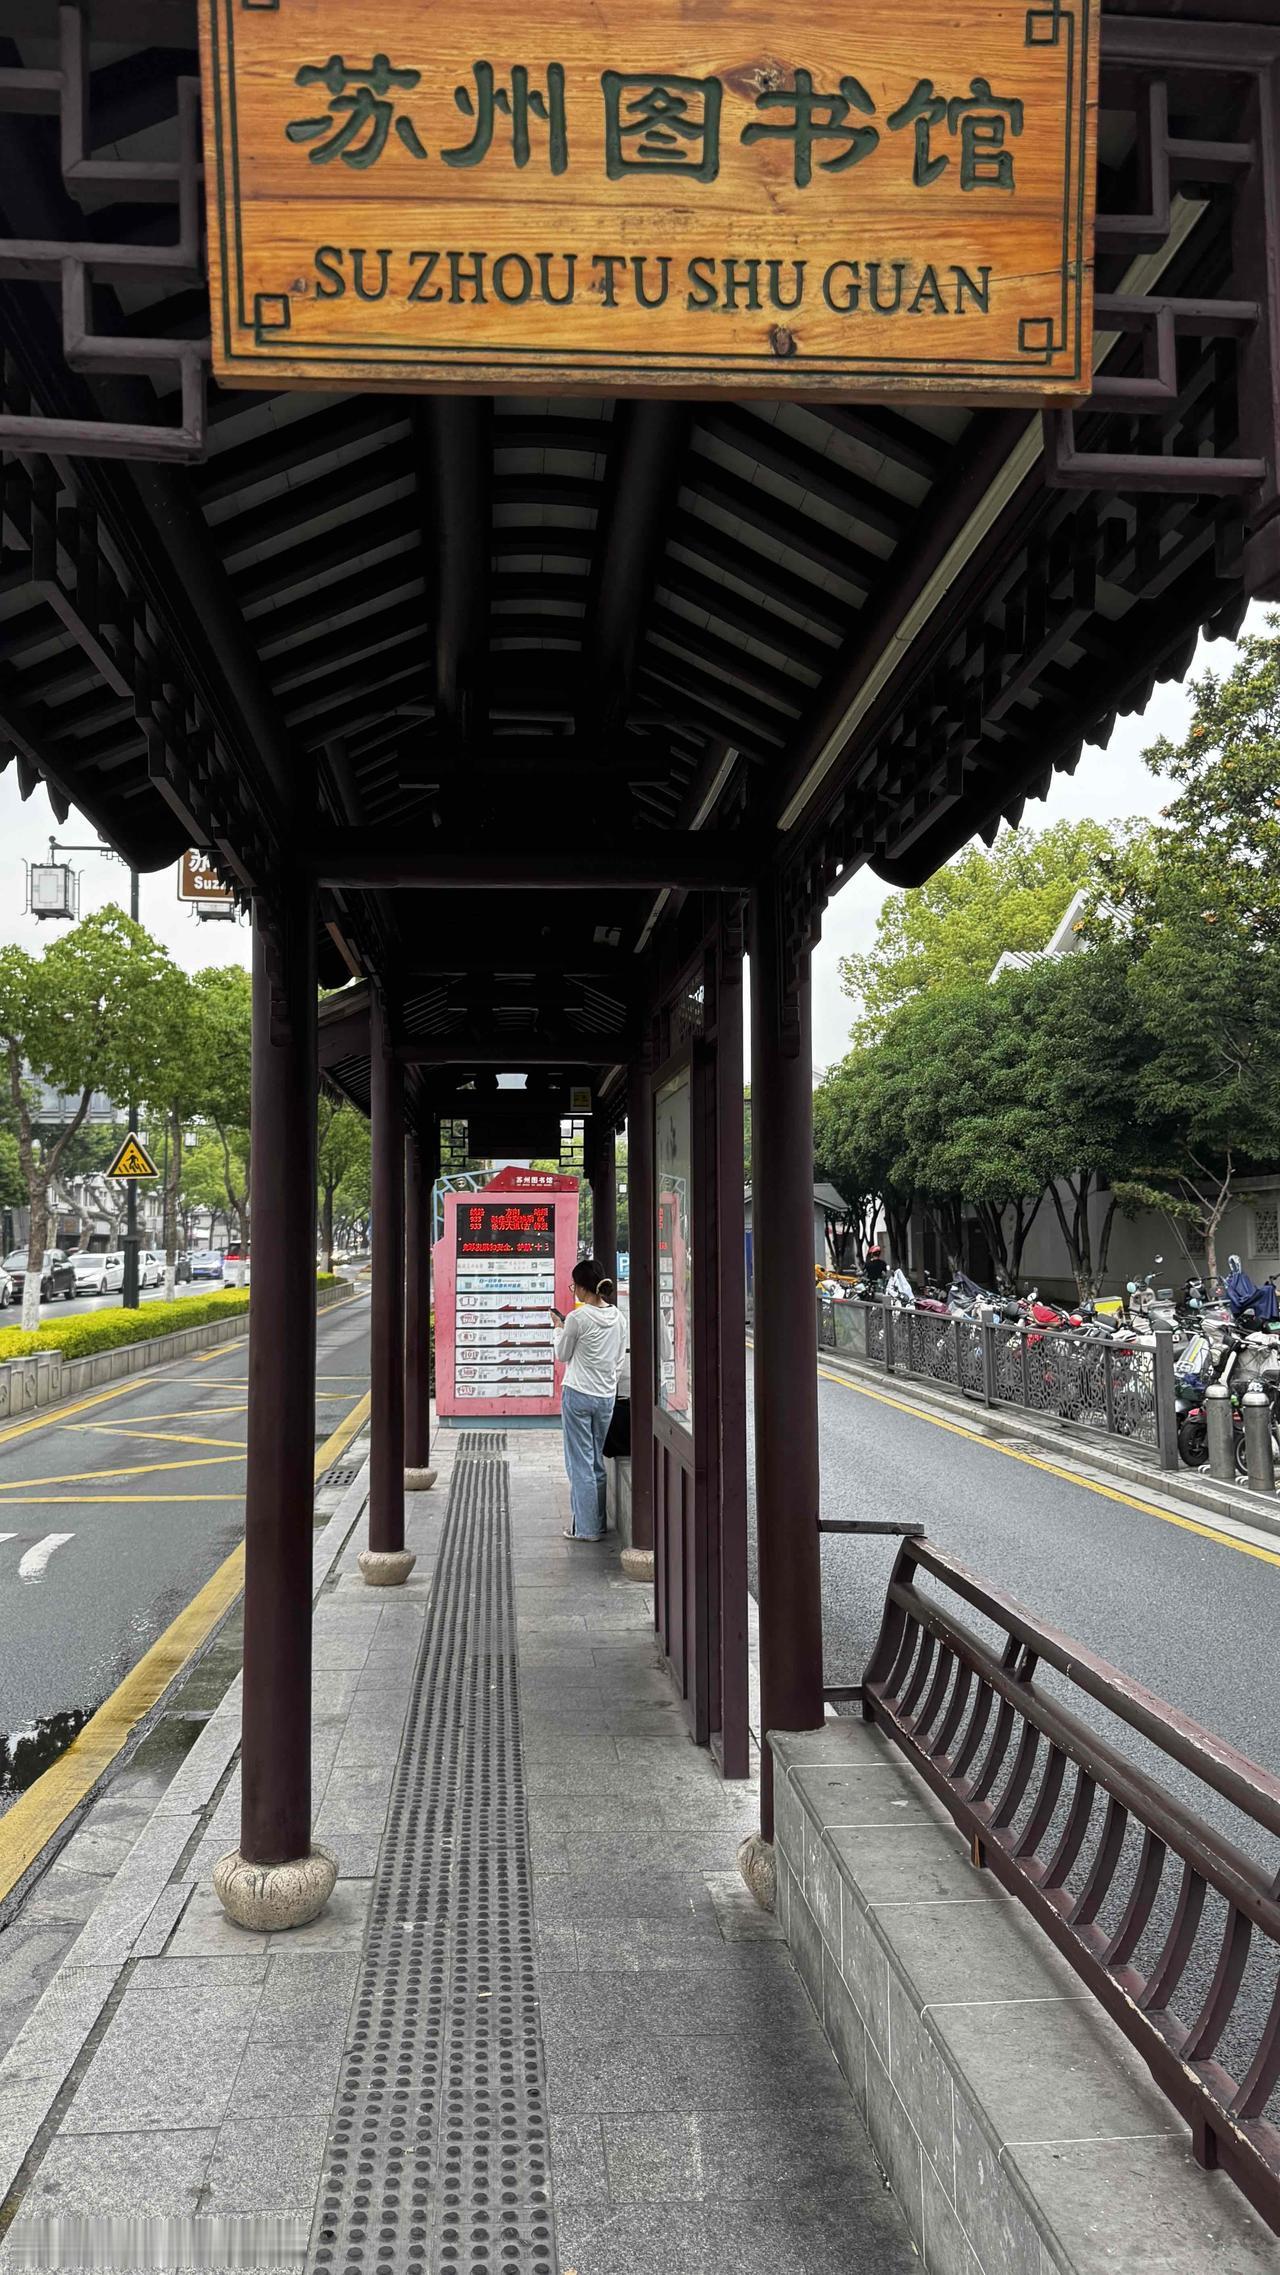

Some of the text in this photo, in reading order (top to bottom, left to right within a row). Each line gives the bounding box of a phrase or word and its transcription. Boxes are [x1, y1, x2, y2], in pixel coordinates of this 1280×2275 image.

[285, 52, 1024, 190] 苏州图书馆
[315, 246, 993, 316] SU ZHOU TU SHU GUAN
[188, 848, 217, 872] 苏
[193, 876, 234, 890] Suz
[515, 1176, 554, 1184] 苏州图书馆
